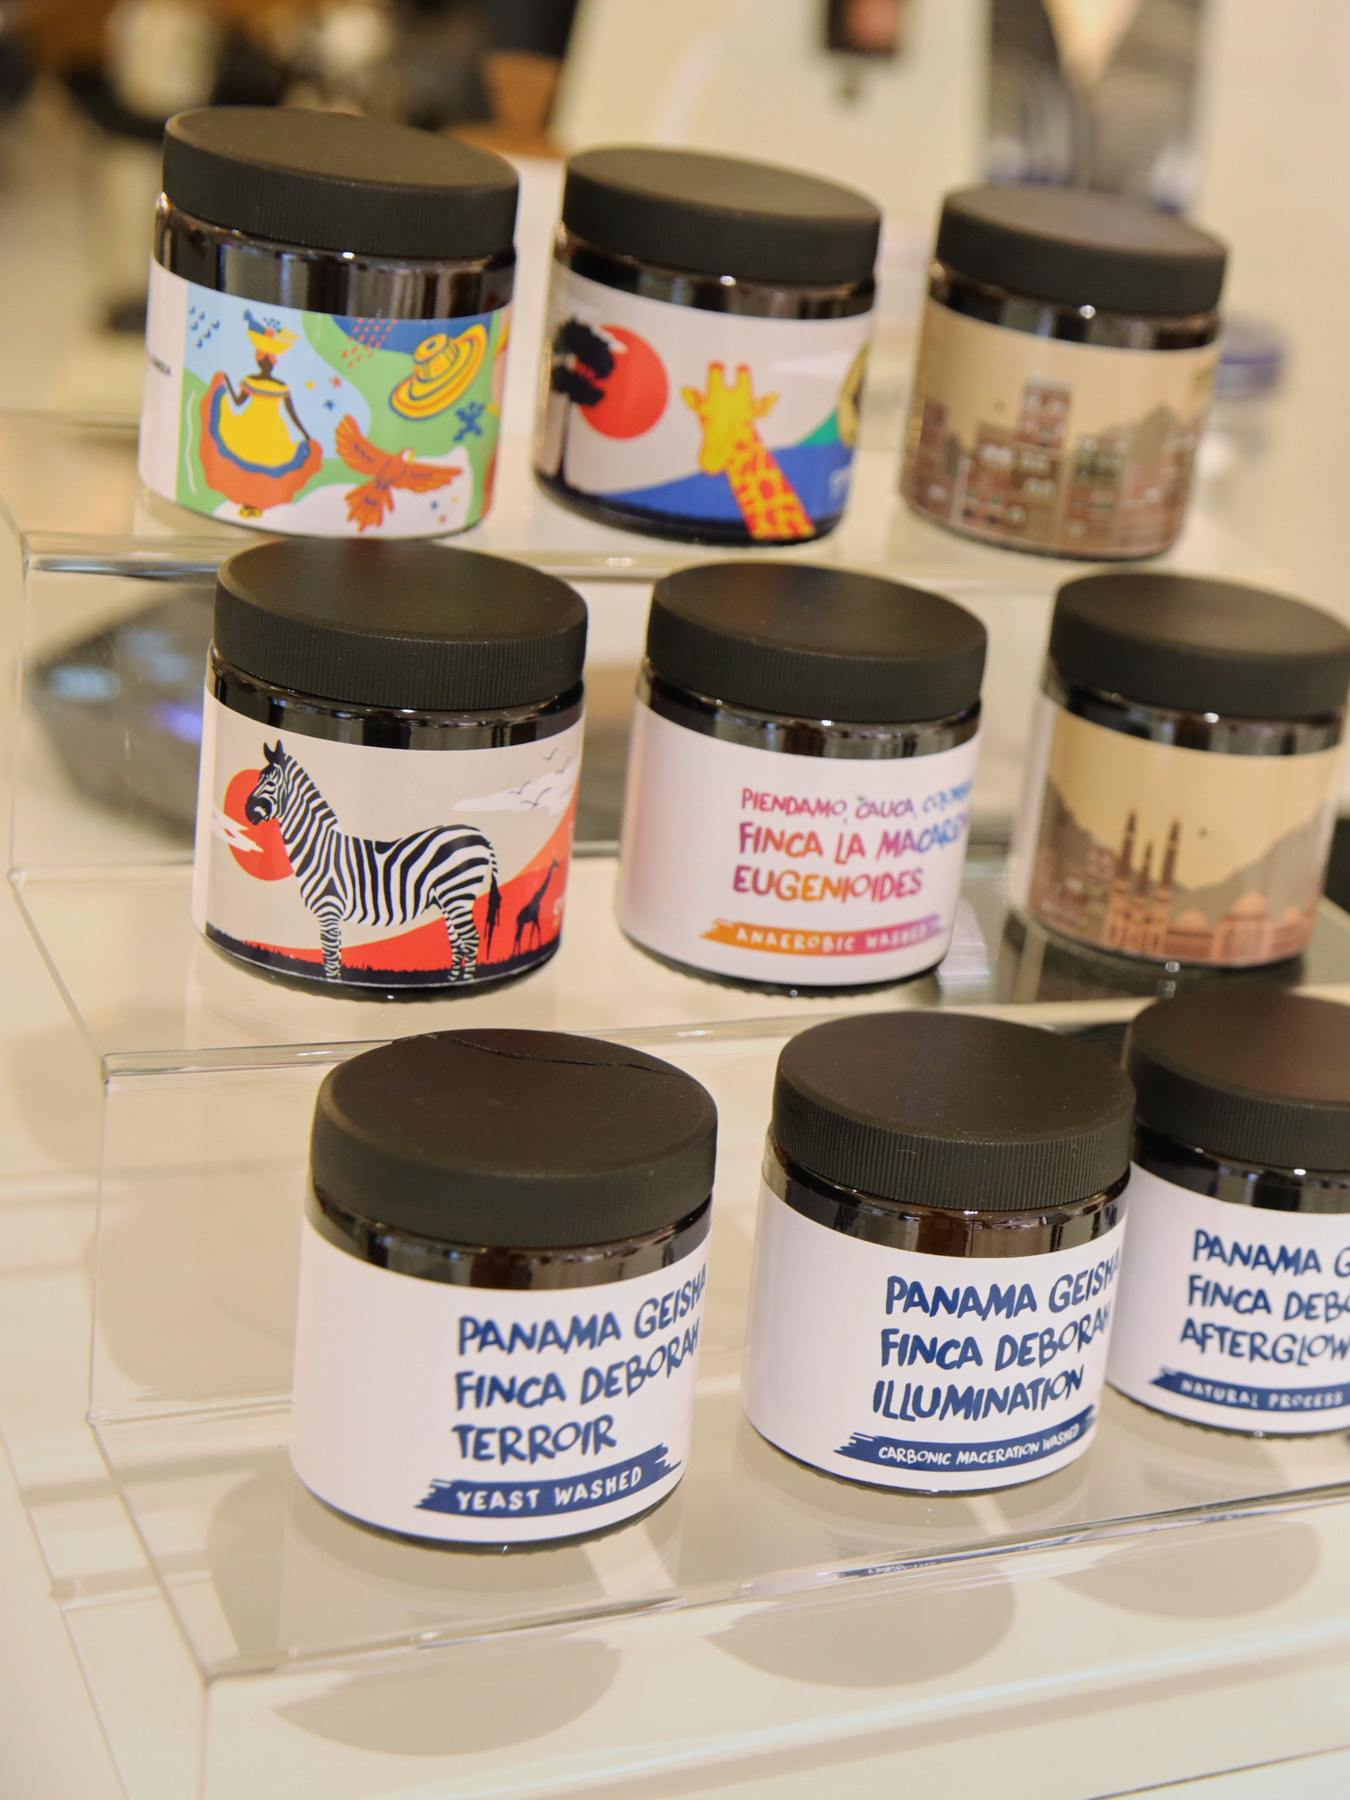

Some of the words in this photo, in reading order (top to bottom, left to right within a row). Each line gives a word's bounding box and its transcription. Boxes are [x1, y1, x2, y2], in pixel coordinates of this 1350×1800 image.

[739, 822, 823, 858] FINCA
[834, 832, 866, 865] LA
[733, 865, 924, 903] EUGENIOIDES
[736, 927, 856, 953] ANAEROBIC
[1193, 1228, 1323, 1276] PANAMA
[458, 1312, 621, 1355] PANAMA
[634, 1262, 706, 1339] GEISHA
[886, 1275, 1037, 1321] PANAMA
[1188, 1274, 1272, 1316] FINCA
[881, 1328, 984, 1371] FINCA
[995, 1299, 1111, 1371] DEBORAH
[455, 1370, 566, 1411] FINCA
[580, 1316, 699, 1406] DEBORAH
[873, 1364, 1085, 1421] ILLUMINATION
[1180, 1379, 1260, 1408] NATURAL
[1268, 1391, 1344, 1409] PROCESS
[451, 1414, 617, 1465] TERROIR
[878, 1446, 951, 1465] CARBONIC
[956, 1442, 1040, 1465] MACERATION
[1042, 1423, 1080, 1451] WASHED
[456, 1489, 540, 1513] YEAST
[555, 1466, 642, 1506] WASHED
